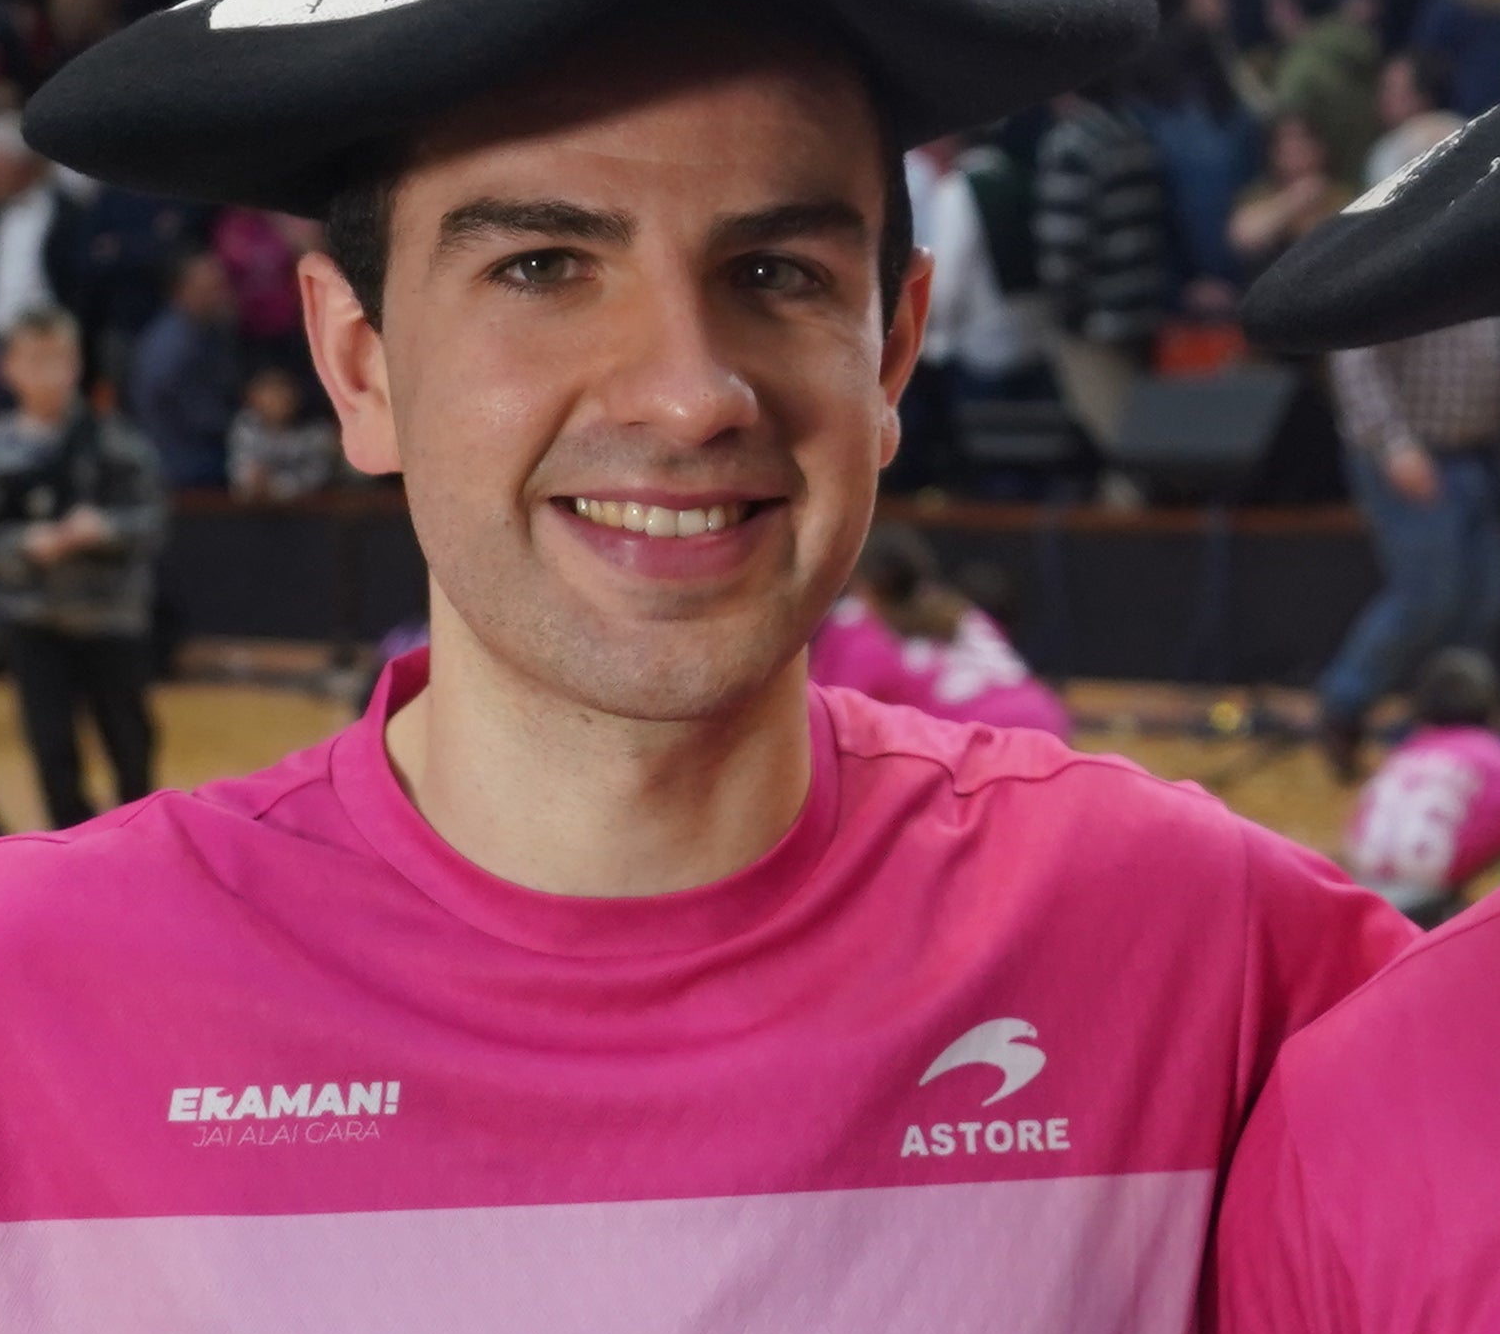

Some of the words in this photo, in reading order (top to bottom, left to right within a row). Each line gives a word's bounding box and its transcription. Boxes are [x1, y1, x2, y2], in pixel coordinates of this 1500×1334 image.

[168, 1080, 401, 1122] ERAMAN!
[193, 1125, 232, 1148] JAI
[238, 1123, 298, 1146] ALAI
[900, 1118, 1071, 1157] ASTORE
